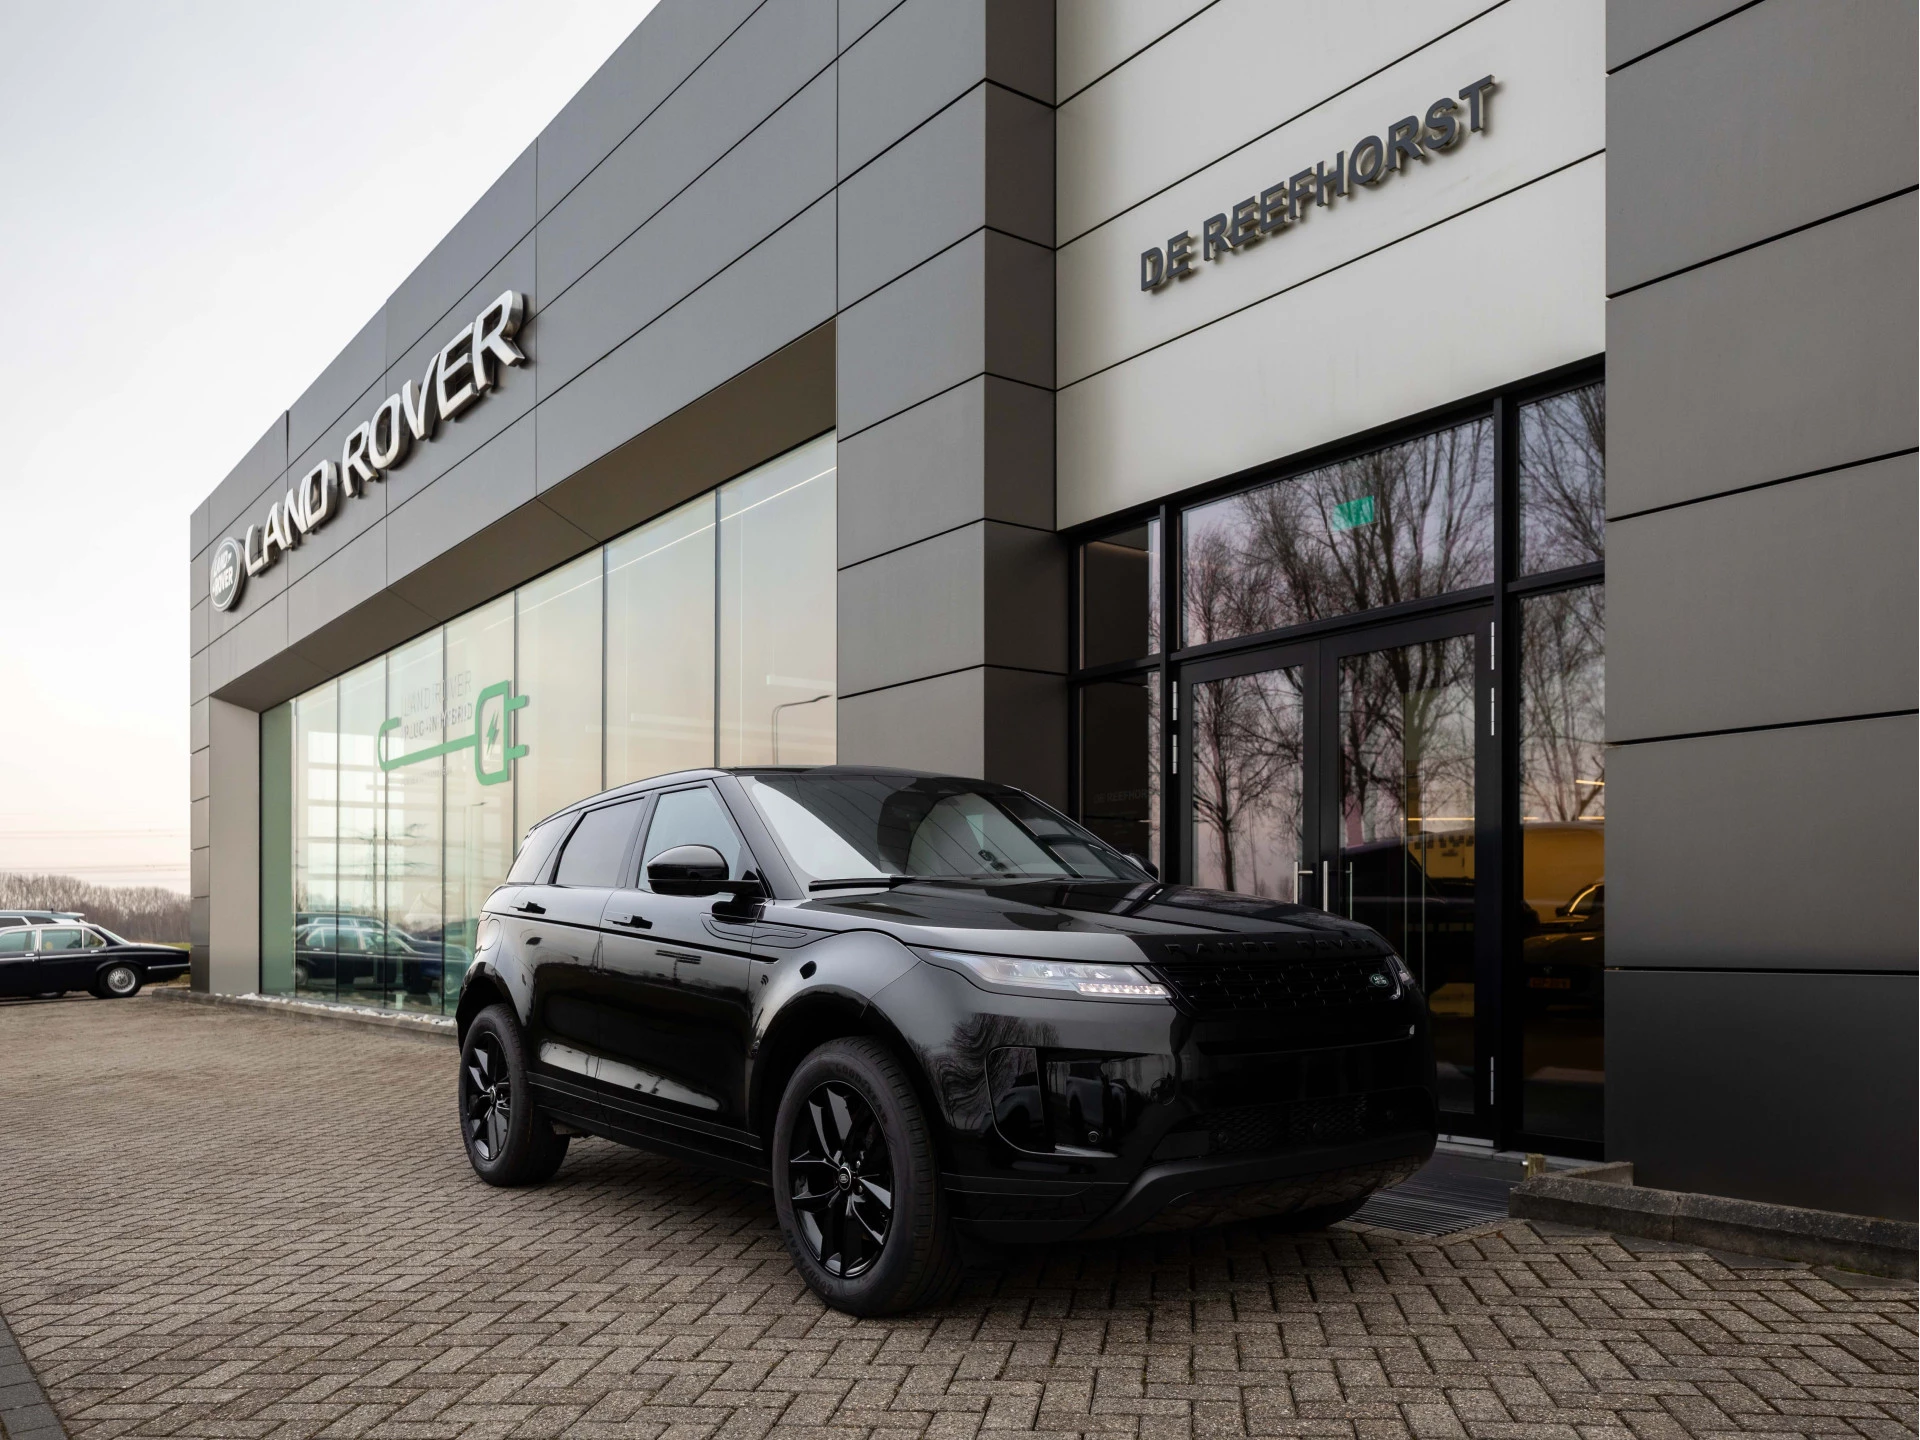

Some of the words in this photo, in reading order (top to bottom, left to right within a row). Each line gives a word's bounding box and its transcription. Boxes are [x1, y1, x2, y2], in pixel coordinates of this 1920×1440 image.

[1140, 230, 1191, 292] DE
[1203, 74, 1495, 262] REEFHORST
[244, 459, 337, 577] LAND
[341, 289, 526, 499] ROVER
[213, 565, 234, 597] ROVER
[404, 687, 431, 717] LAND
[433, 670, 473, 704] ROVER
[403, 715, 438, 741] PLUG-IN
[440, 702, 474, 730] HYBRID
